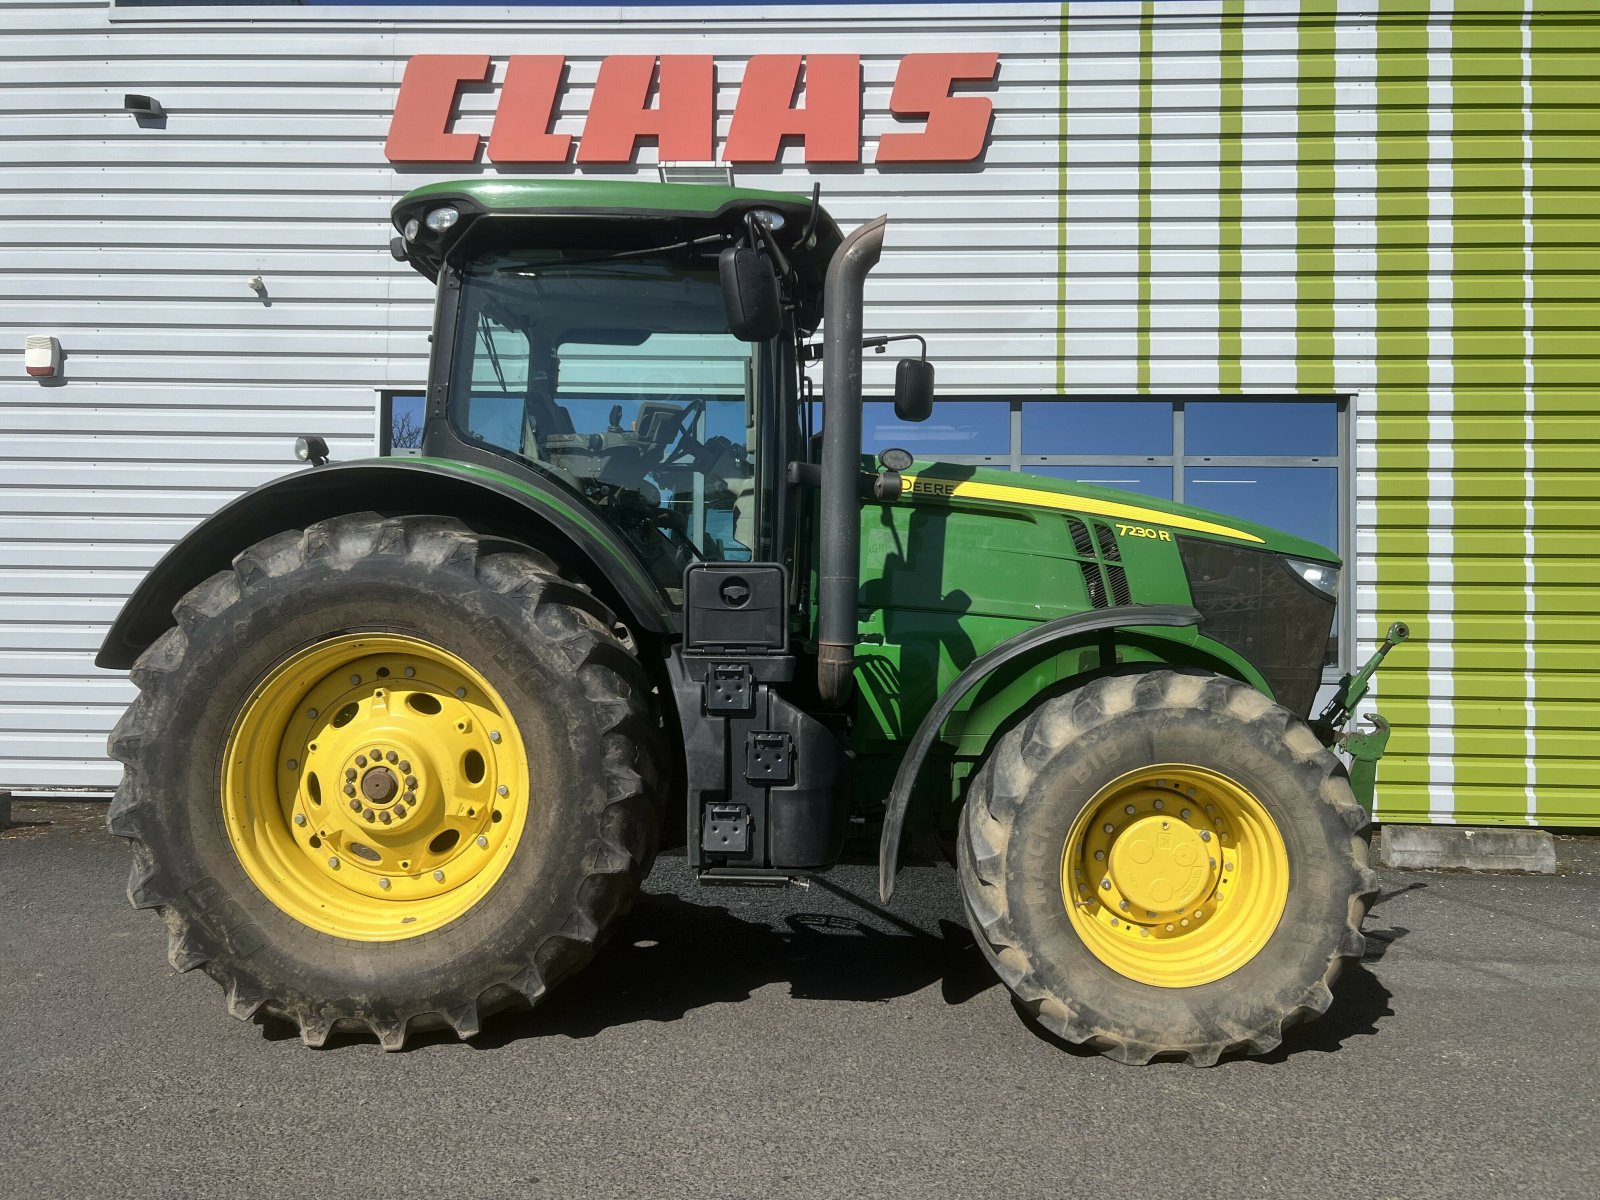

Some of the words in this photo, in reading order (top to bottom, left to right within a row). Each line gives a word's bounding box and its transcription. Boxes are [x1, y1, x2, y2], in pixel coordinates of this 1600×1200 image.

[384, 52, 1000, 163] CLAAS
[901, 478, 955, 495] DEERE
[1115, 523, 1157, 539] 7230
[1158, 529, 1171, 542] R
